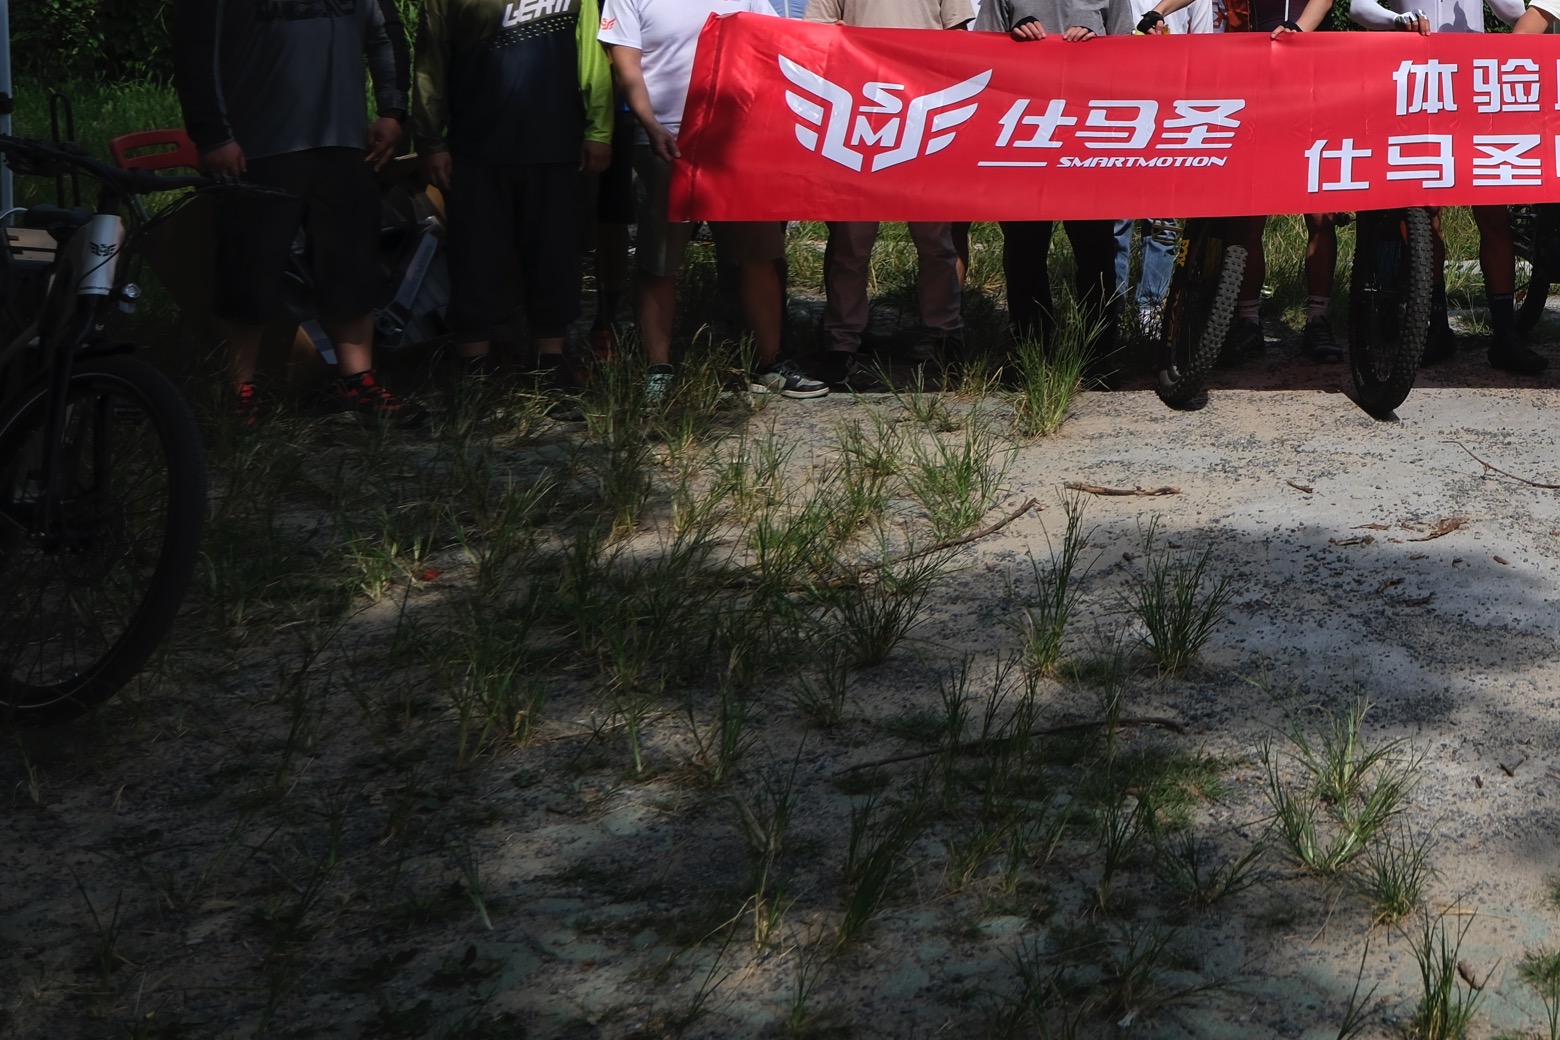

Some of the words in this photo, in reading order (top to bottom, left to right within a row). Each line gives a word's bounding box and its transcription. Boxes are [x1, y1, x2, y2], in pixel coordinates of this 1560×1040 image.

[994, 98, 1247, 150] 仕马圣
[1056, 155, 1228, 169] SMARTMOTION
